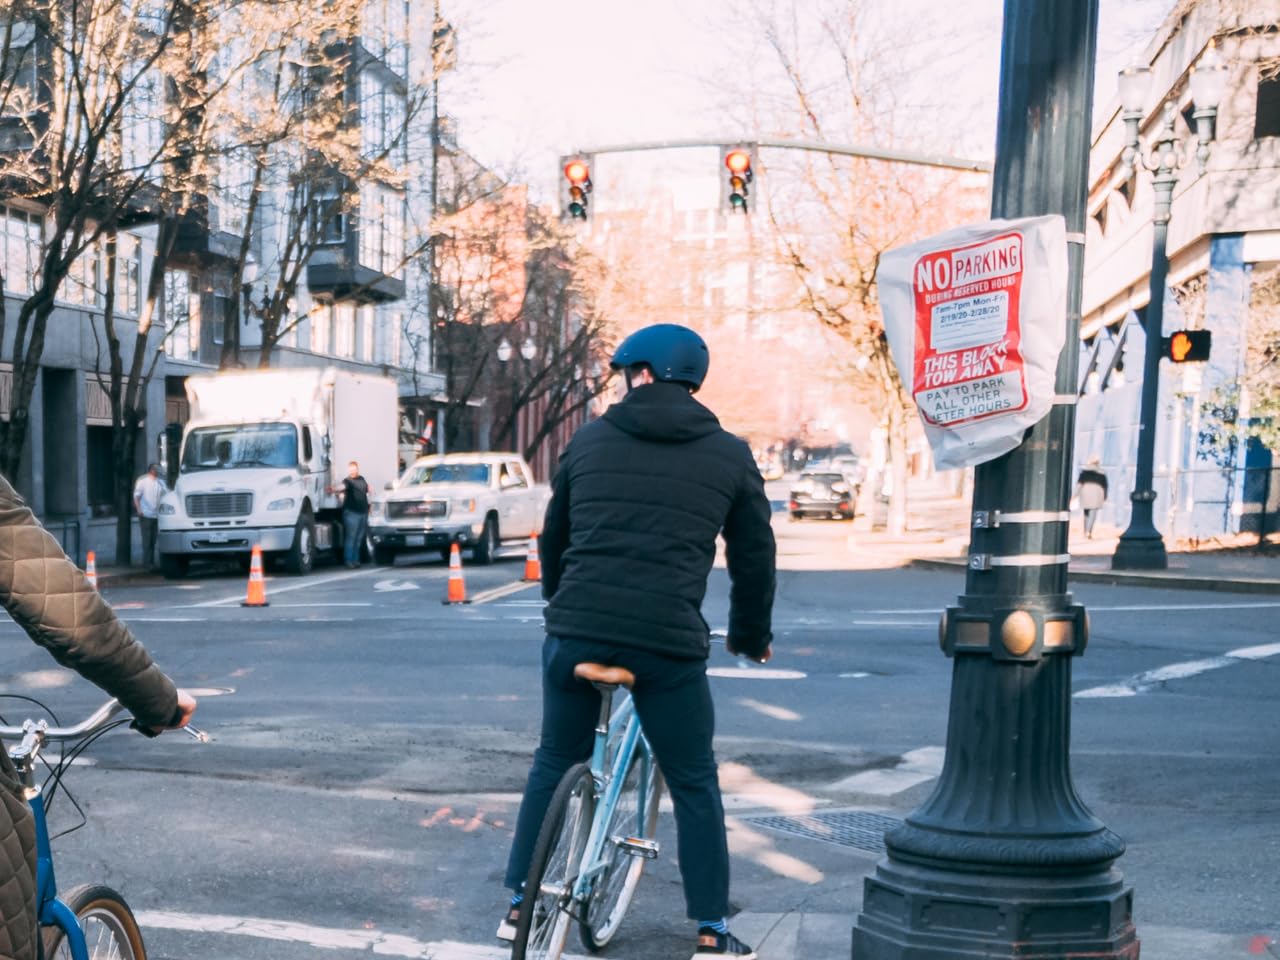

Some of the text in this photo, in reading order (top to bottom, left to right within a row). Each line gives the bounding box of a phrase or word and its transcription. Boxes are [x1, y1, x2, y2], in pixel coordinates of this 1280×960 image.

[917, 245, 1017, 293] NO PARKING
[925, 275, 1016, 304] DURING RESERVED HOURS
[924, 340, 1010, 374] THIS BLOCK
[925, 355, 1008, 388] TOW AWAY
[927, 377, 1006, 403] PAY TO PARK
[935, 389, 1000, 412] ALL OTHER
[969, 399, 1012, 415] HOURS
